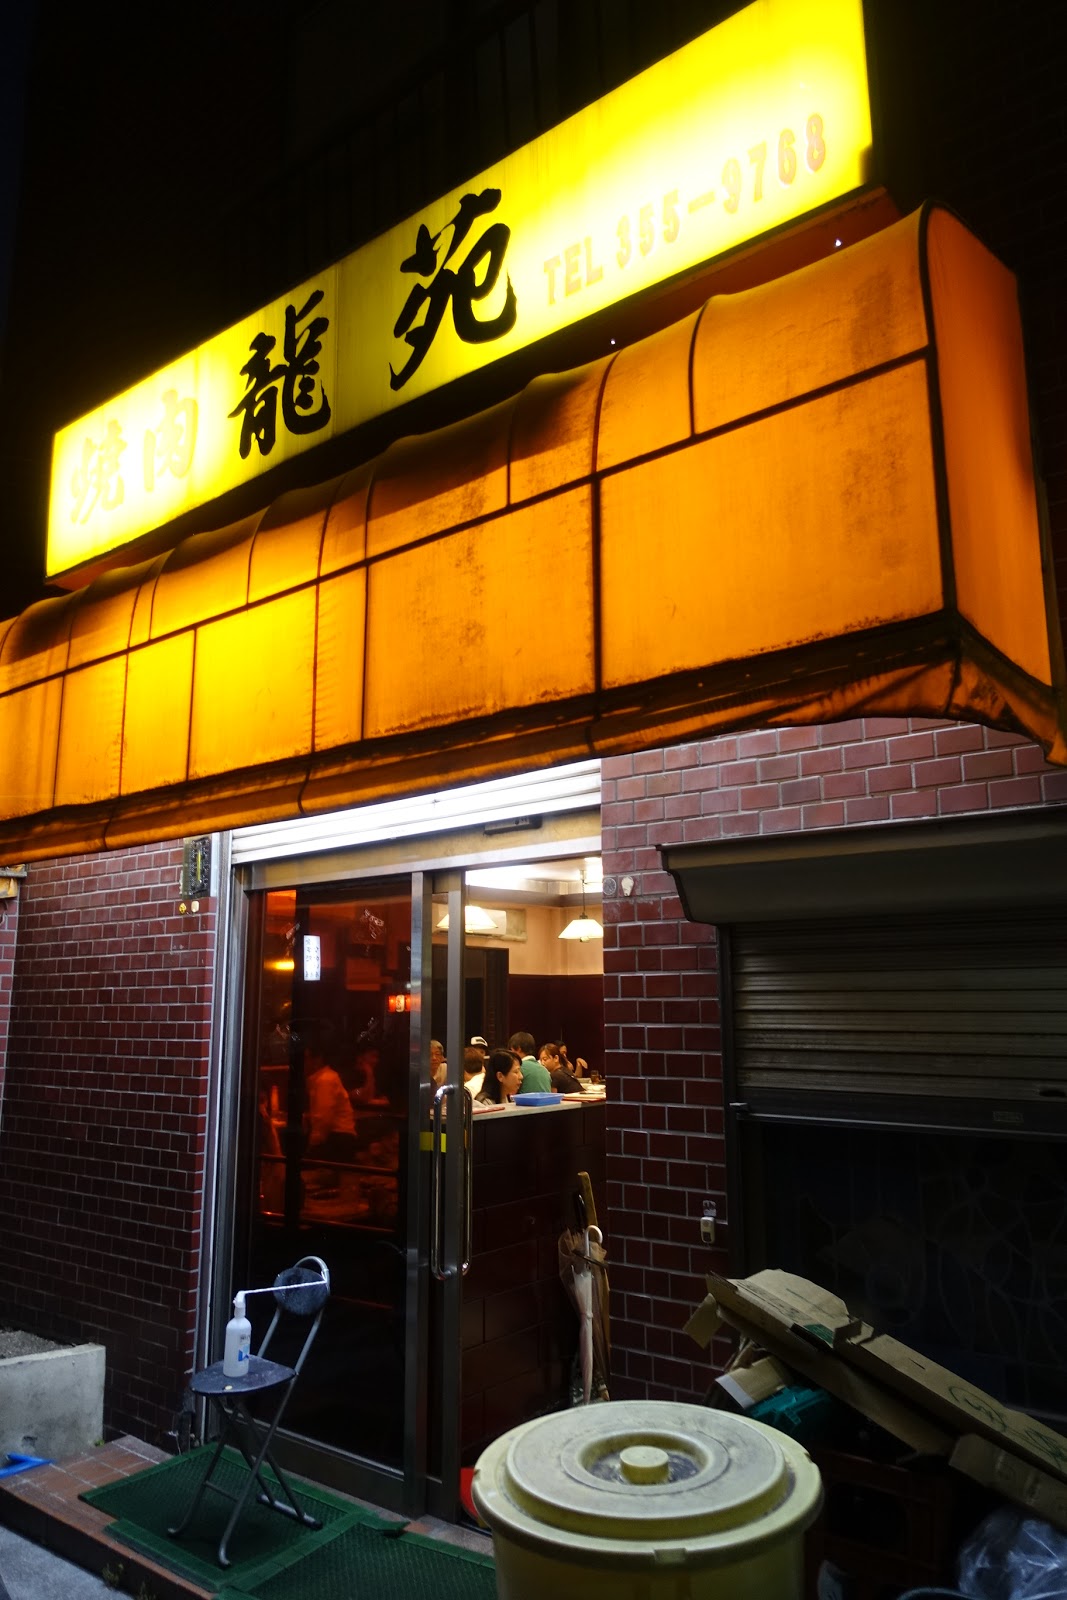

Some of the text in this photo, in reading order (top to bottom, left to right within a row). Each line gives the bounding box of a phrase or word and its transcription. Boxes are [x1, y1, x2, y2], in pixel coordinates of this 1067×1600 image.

[228, 188, 518, 459] 龍苑
[543, 112, 827, 306] TEL 355-9768
